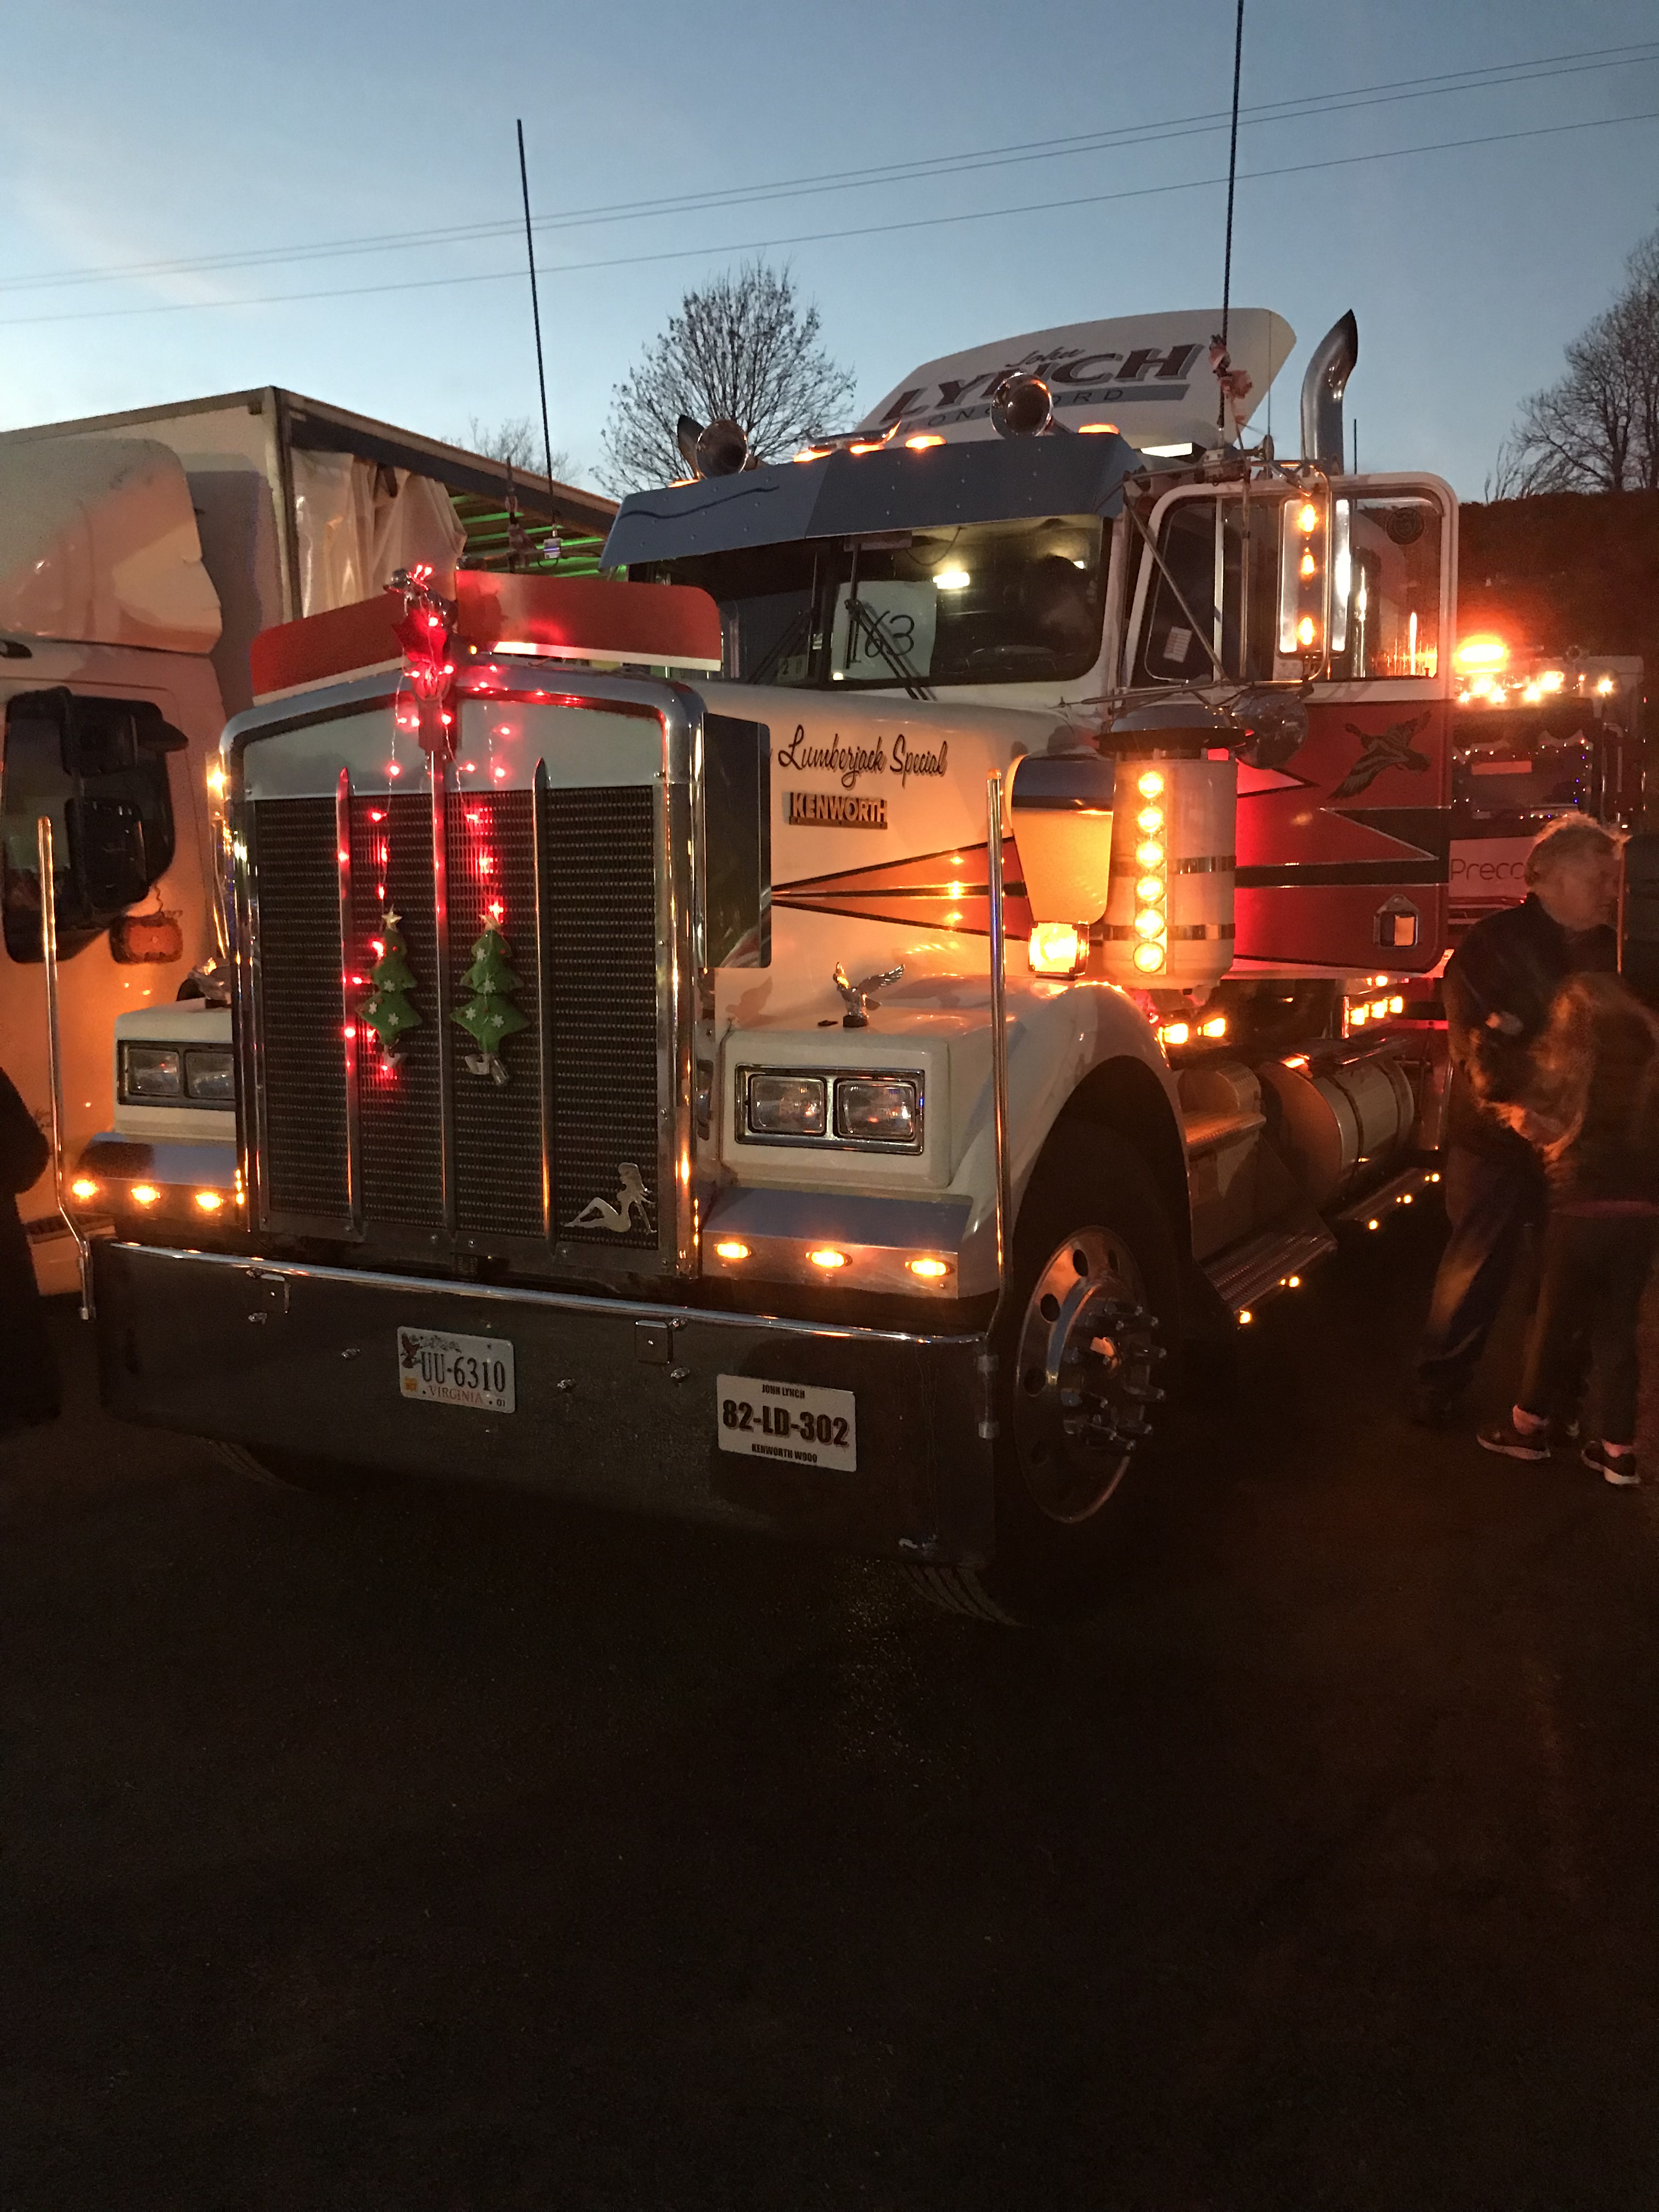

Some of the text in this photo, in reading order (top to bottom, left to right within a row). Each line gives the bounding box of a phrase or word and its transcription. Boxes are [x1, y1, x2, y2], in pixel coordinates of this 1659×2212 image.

[778, 724, 948, 790] Lumberjack Special
[791, 792, 887, 823] KENWORTH
[421, 1351, 506, 1392] UU-6310
[428, 1385, 483, 1404] VIRGINIA
[762, 1384, 805, 1399] JOHN LYNCH
[723, 1399, 850, 1448] 82-LD-302
[752, 1443, 818, 1463] KENWORTH W900
